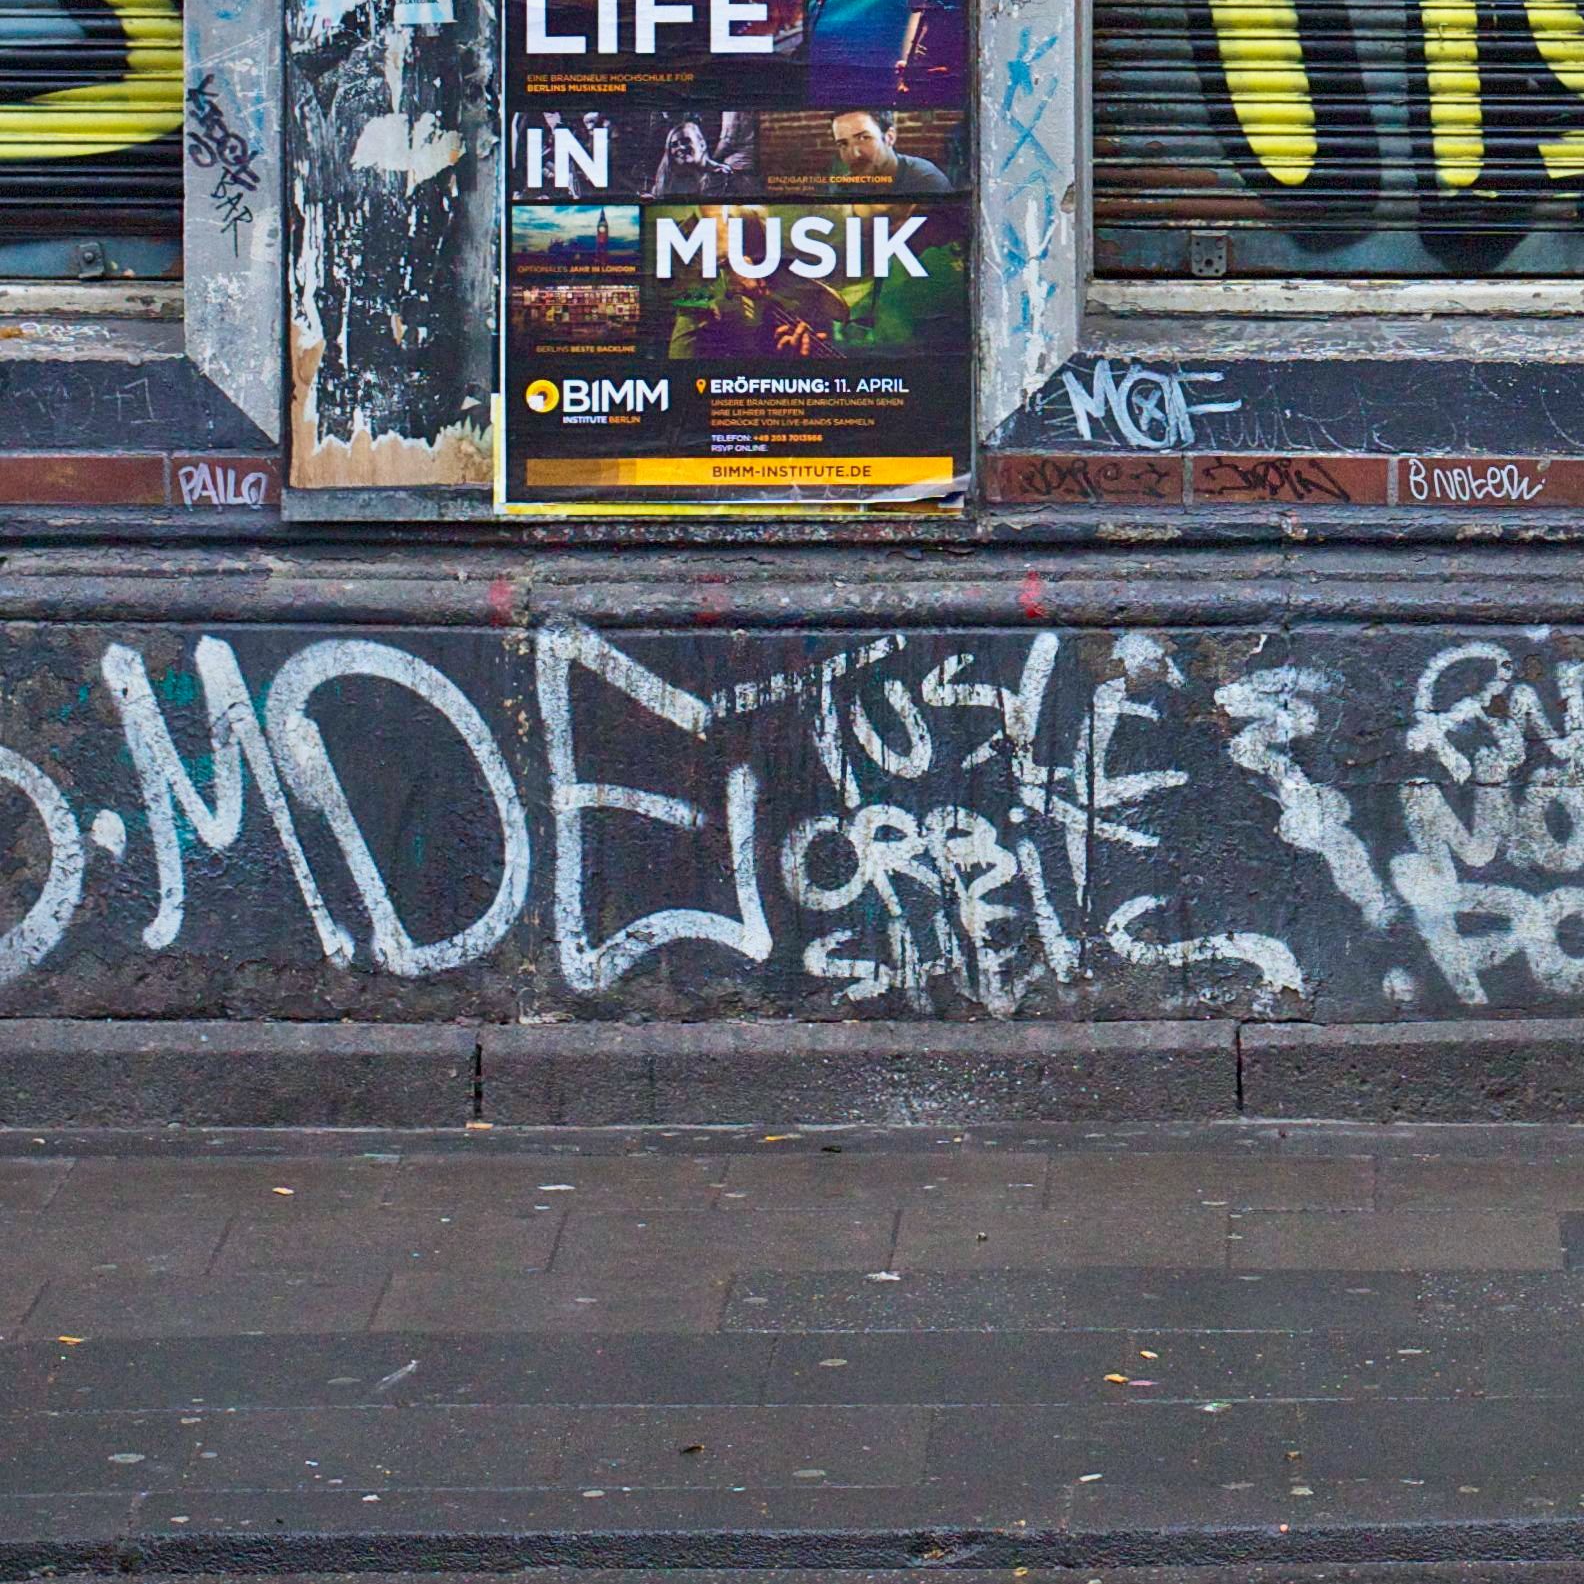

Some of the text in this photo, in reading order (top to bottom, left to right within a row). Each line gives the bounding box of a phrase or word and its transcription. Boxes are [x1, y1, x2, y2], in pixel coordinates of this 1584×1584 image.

[527, 83, 627, 93] BERLINS MUSIKSZENE
[526, 128, 608, 189] IN
[829, 175, 893, 184] CONNECTIONS
[656, 216, 929, 279] MUSIK
[711, 377, 909, 393] ERÖFFNUNG: 11. APRIL
[563, 379, 669, 413] BIMM
[563, 415, 640, 425] INSTITUTE BERLIN
[711, 434, 751, 443] TELEFON:
[711, 444, 733, 453] RSVP
[712, 465, 872, 478] BIMM-INSTITUTE.DE
